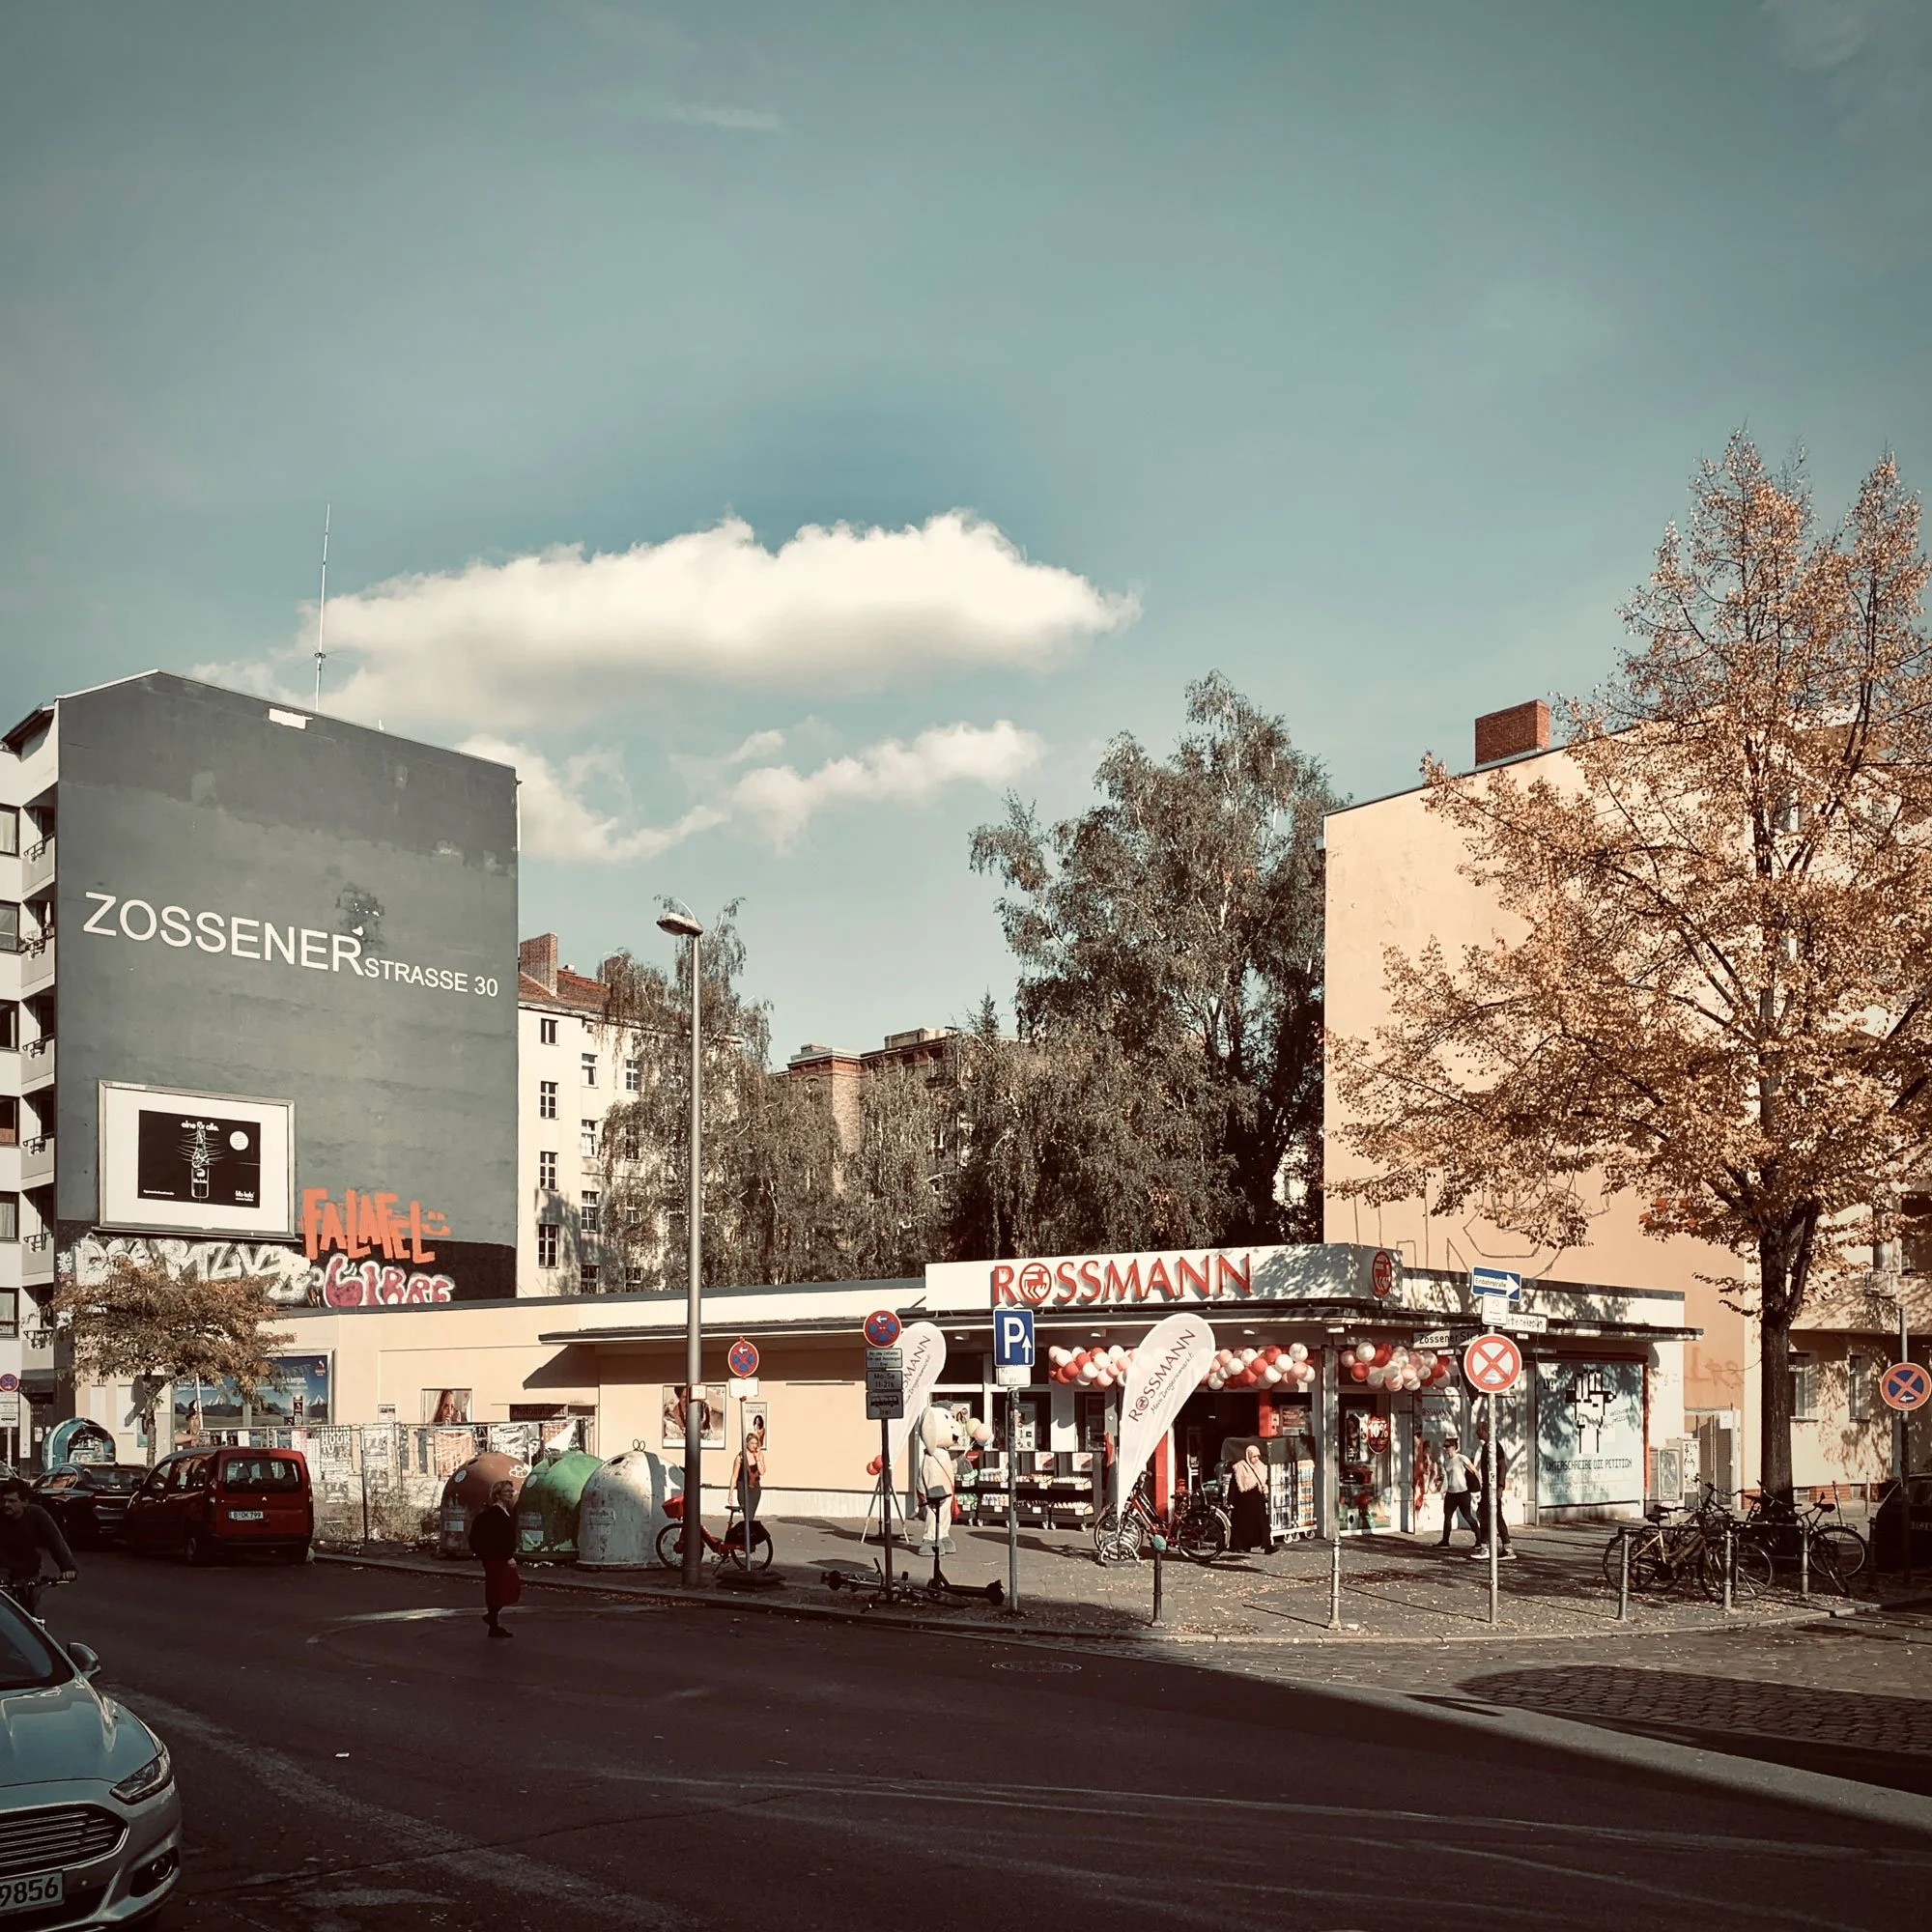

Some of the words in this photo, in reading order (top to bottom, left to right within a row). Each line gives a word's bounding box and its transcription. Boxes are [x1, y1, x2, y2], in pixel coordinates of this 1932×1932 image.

[83, 892, 364, 976] ZOSSENER
[363, 957, 469, 993] STRASSE
[473, 976, 498, 997] 30
[302, 1188, 437, 1264] FALAFEL
[993, 1253, 1251, 1304] ROSSMANN
[1003, 1317, 1025, 1359] P
[1419, 1333, 1459, 1344] Zossener
[1128, 1329, 1196, 1422] ROSSMANN
[1546, 1459, 1592, 1471] UNTERSCHREIBE
[1593, 1459, 1604, 1469] DIE
[1605, 1458, 1633, 1469] PETITION
[0, 1877, 59, 1908] 9856
